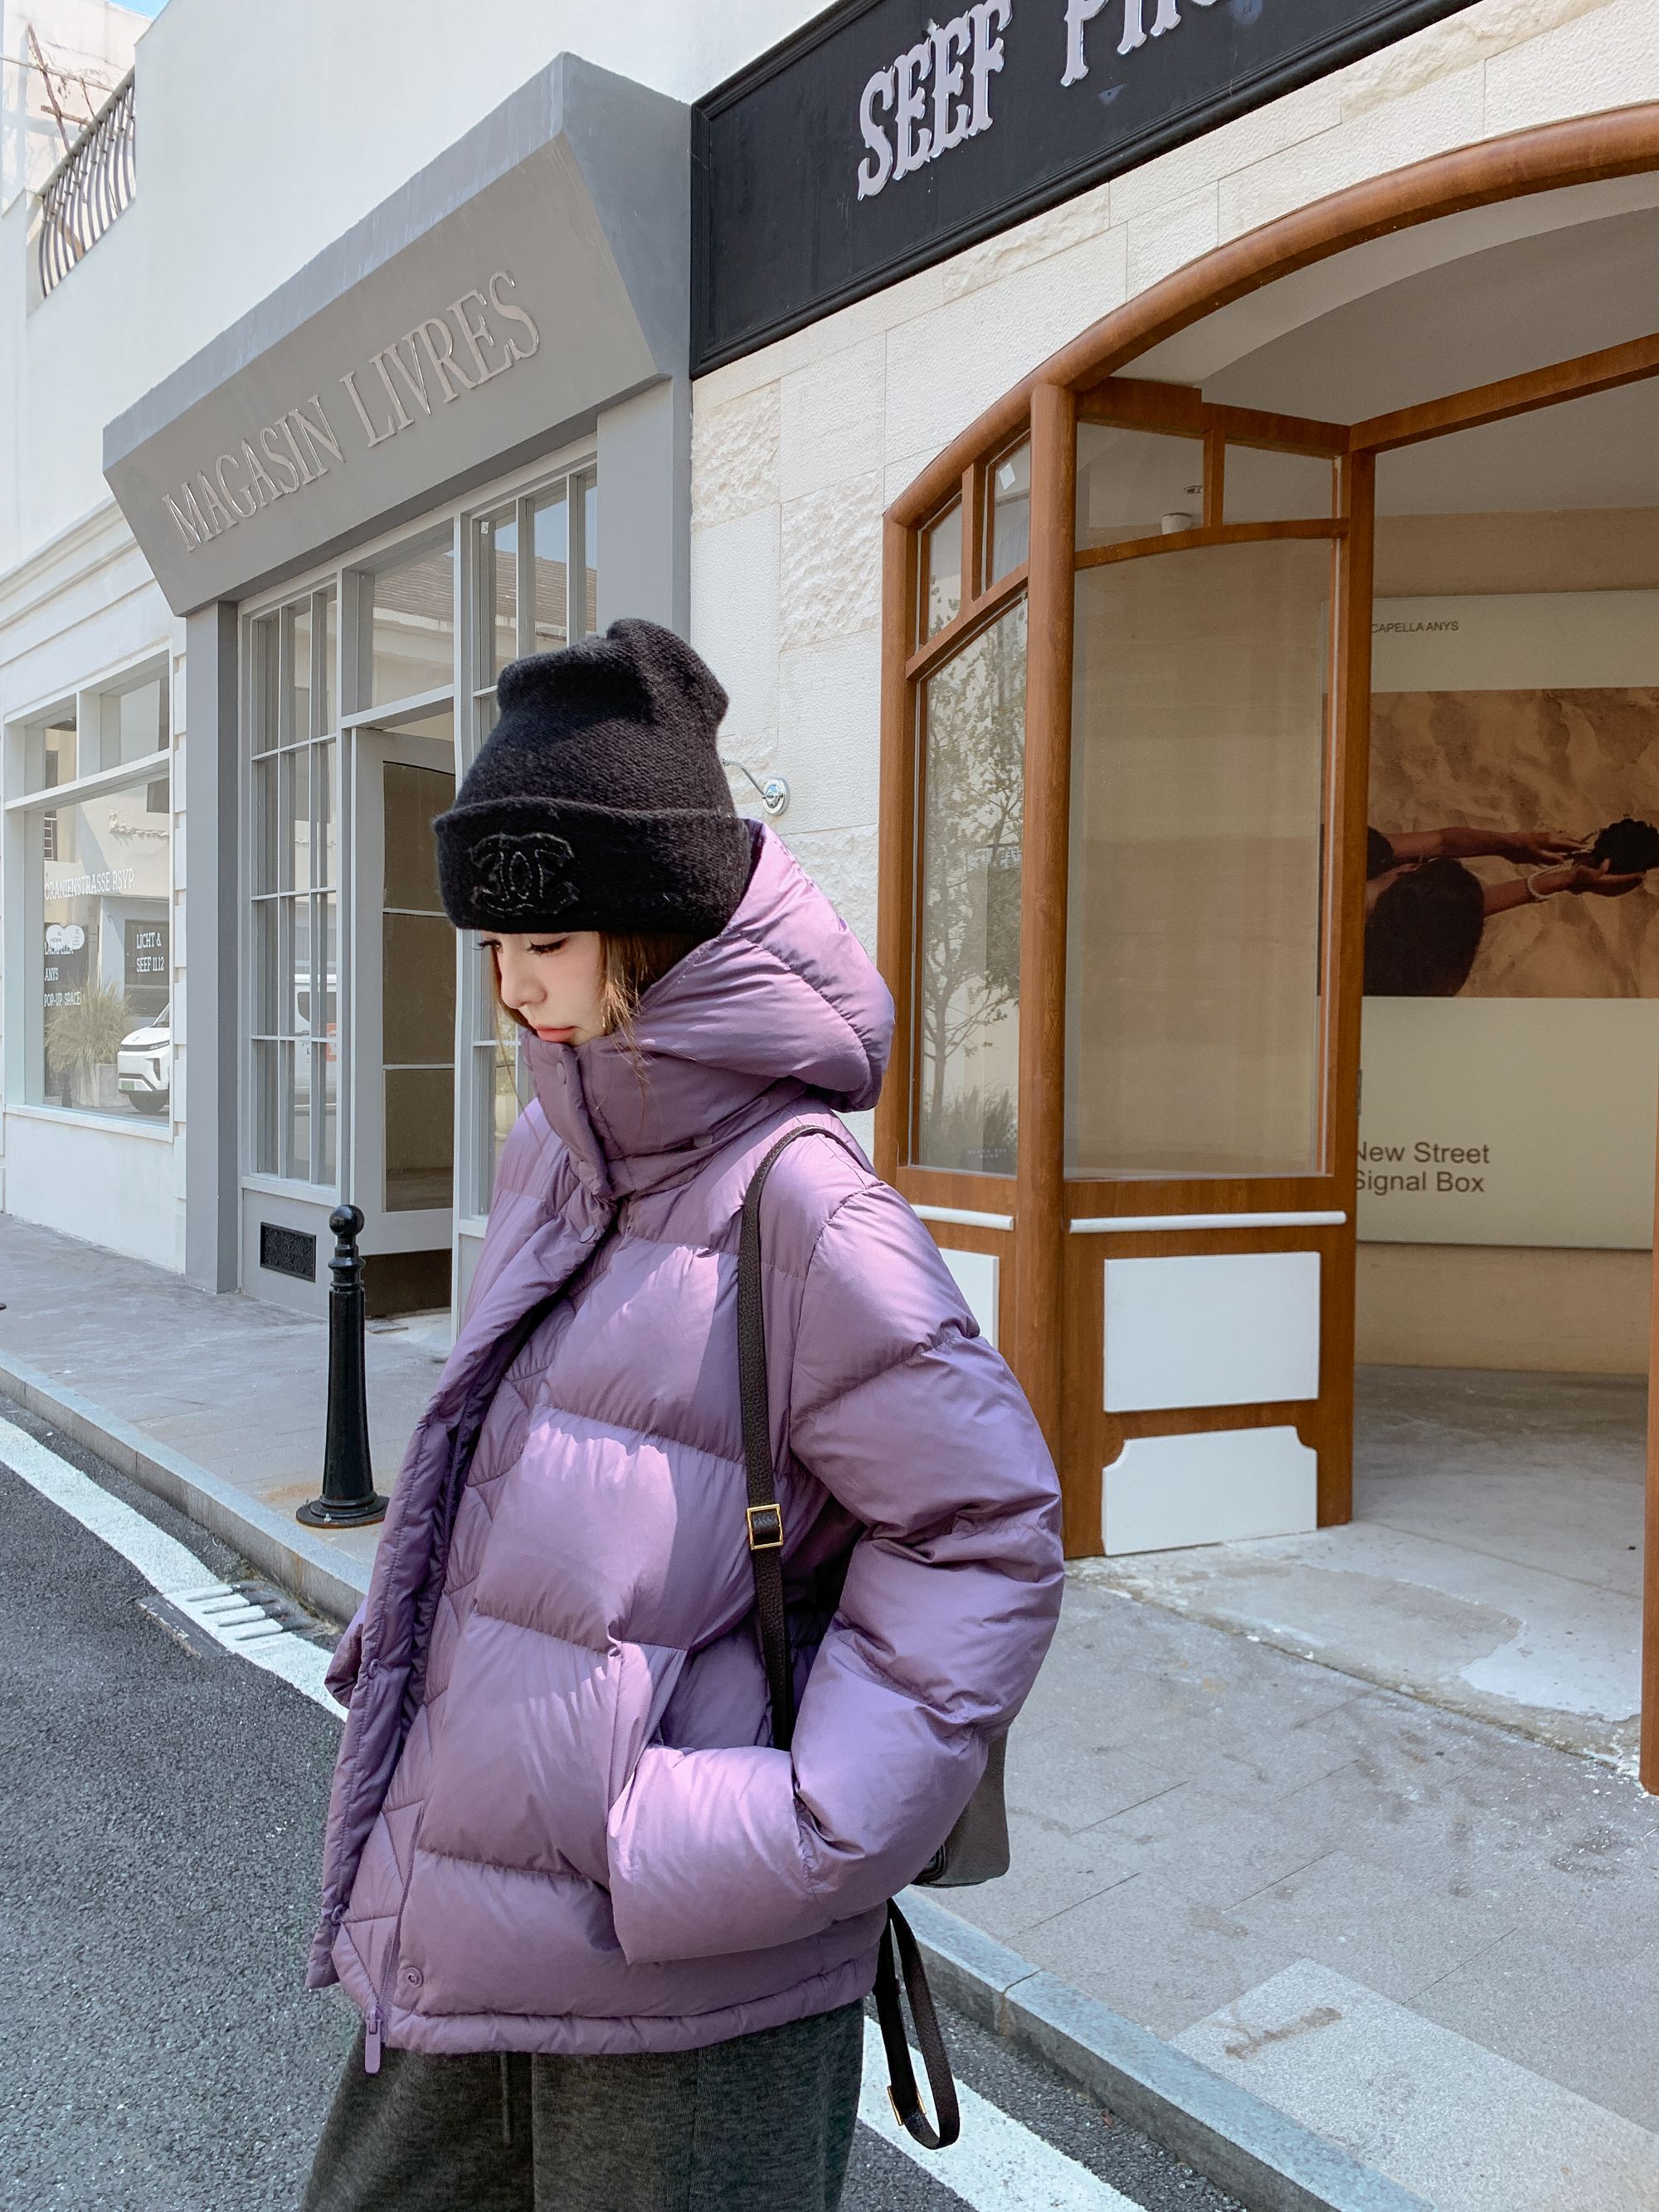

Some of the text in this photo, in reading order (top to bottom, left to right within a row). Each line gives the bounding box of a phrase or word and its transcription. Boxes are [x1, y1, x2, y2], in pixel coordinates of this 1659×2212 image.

[858, 0, 1014, 200] SEEF
[162, 269, 540, 553] MAGASIN LIVRES
[1426, 621, 1459, 631] ANYS
[44, 872, 110, 900] ORANIENSTRASSE
[136, 932, 162, 949] LICHT &
[136, 956, 151, 972] SEEF
[44, 992, 80, 1007] POP-UP SPACE
[1413, 1142, 1491, 1164] Street
[1436, 1171, 1485, 1193] Box
